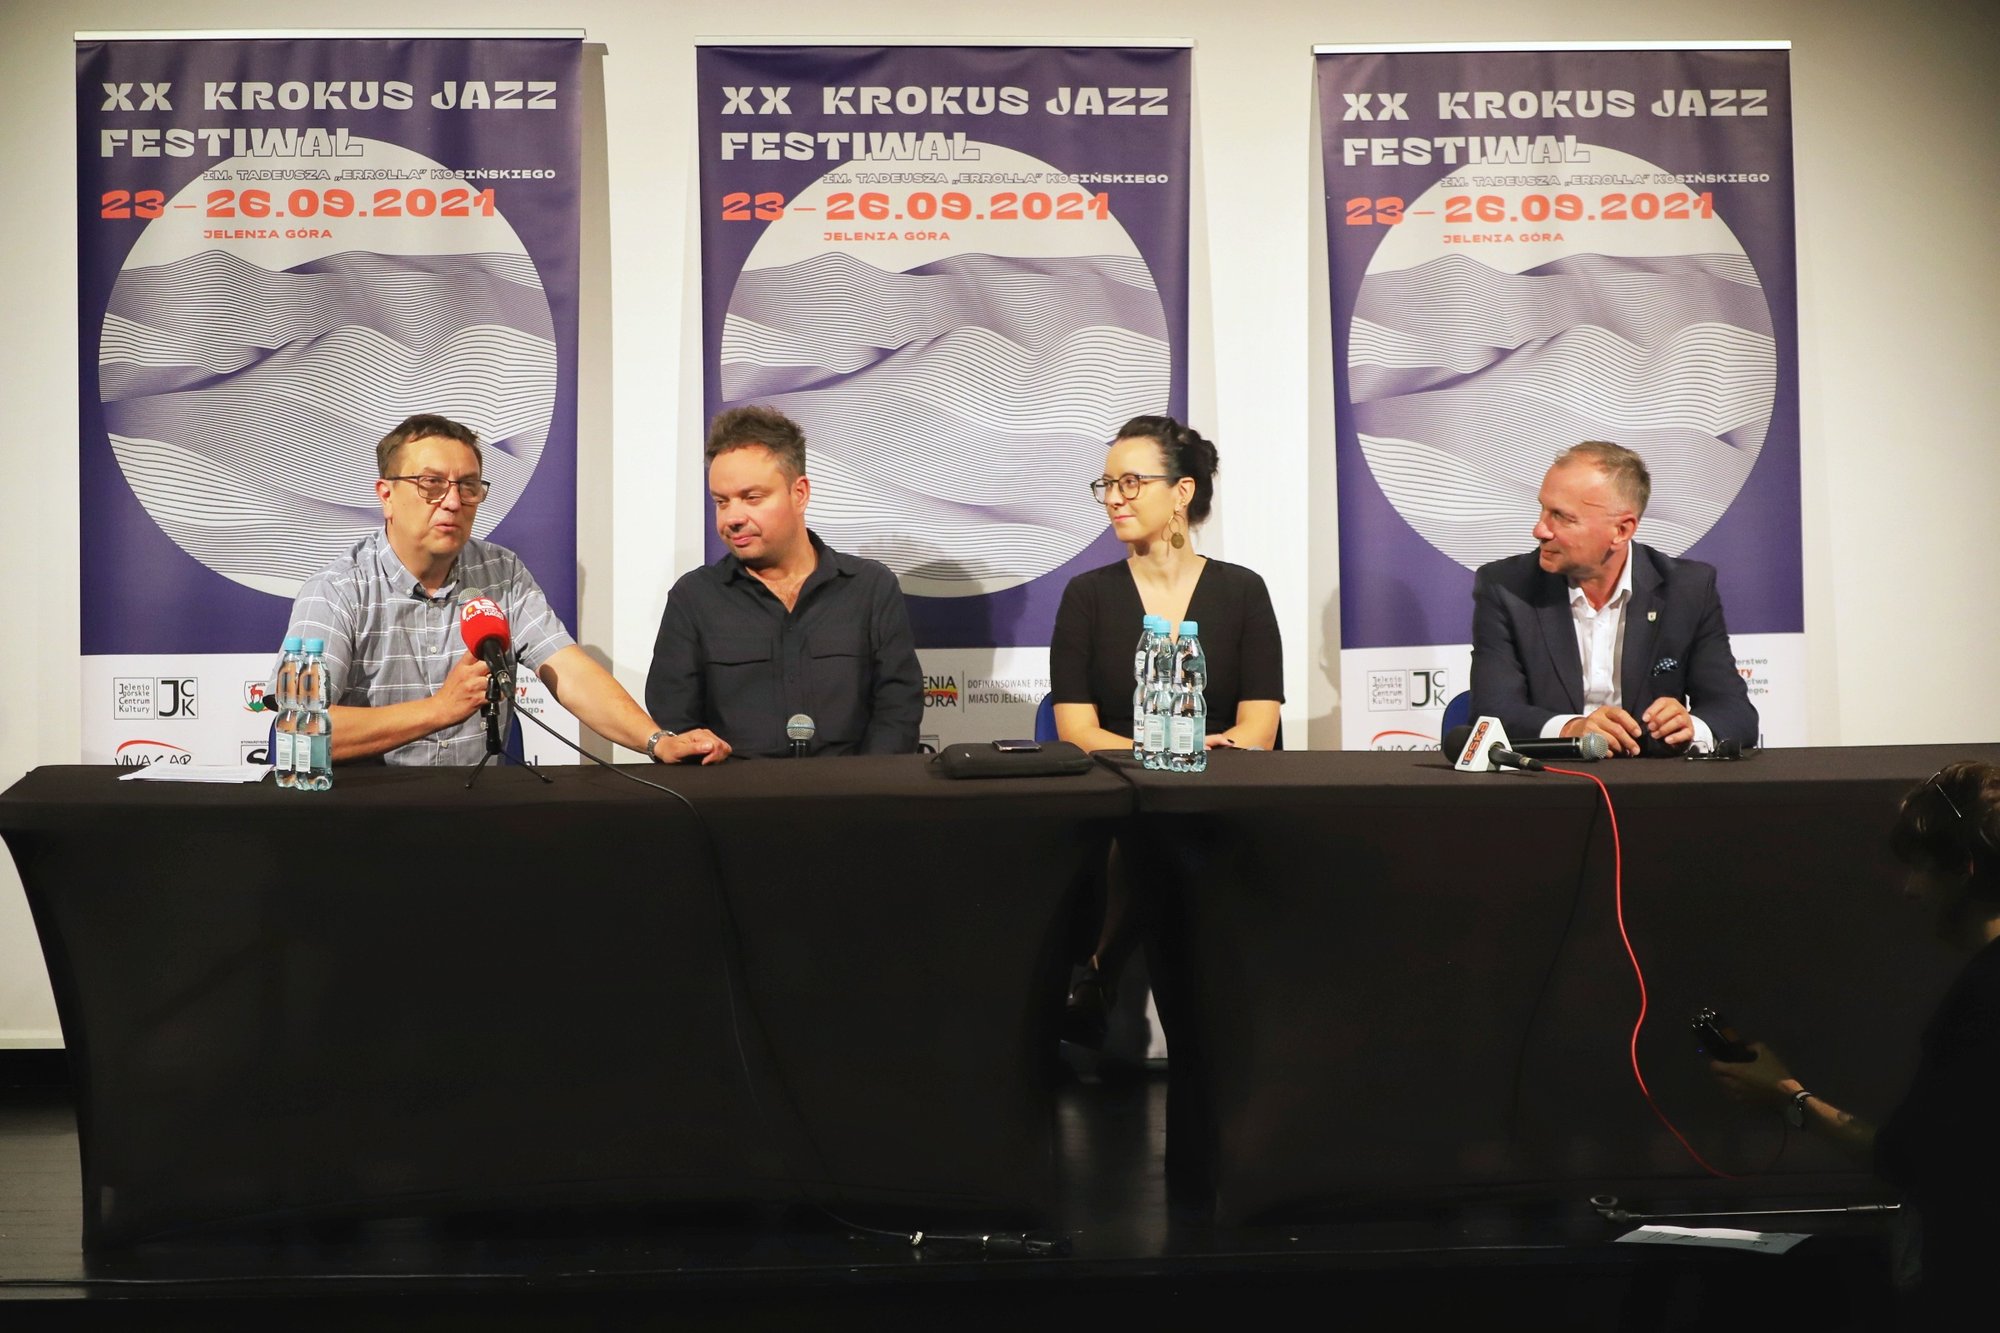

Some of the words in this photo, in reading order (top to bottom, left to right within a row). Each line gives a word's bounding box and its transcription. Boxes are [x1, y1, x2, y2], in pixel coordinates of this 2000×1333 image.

[101, 83, 172, 111] XX
[204, 81, 415, 110] KROKUS
[431, 81, 557, 110] JAZZ
[721, 86, 792, 115] XX
[823, 86, 1029, 115] KROKUS
[1045, 87, 1169, 115] JAZZ
[1342, 92, 1409, 121] XX
[1438, 90, 1636, 120] KROKUS
[1651, 89, 1769, 117] JAZZ
[100, 128, 364, 158] FESTIWAL
[721, 132, 980, 161] FESTIWAL
[1344, 135, 1591, 166] FESTIWAL
[203, 169, 232, 180] IM.
[237, 170, 330, 181] TADEUSZA
[431, 167, 556, 180] KOSIŃSKIEGO
[823, 174, 852, 184] IM.
[855, 174, 949, 184] TADEUSZA
[1046, 171, 1168, 184] KOSIŃSKIEGO
[1441, 177, 1469, 187] IM.
[1472, 176, 1562, 187] TADEUSZA
[1653, 171, 1770, 184] KOSIŃSKIEGO
[101, 189, 165, 219] 23
[206, 188, 495, 218] 26.09.2021
[722, 192, 785, 221] 23
[826, 192, 1110, 221] 26.09.2021
[1345, 196, 1404, 226] 23
[1444, 192, 1714, 224] 26.09.2021
[203, 230, 280, 239] JELENIA
[285, 228, 333, 239] GÓRA
[823, 232, 899, 241] JELENIA
[904, 230, 950, 241] GÓRA
[1442, 234, 1514, 244] JELENIA
[1519, 231, 1564, 243] GÓRA
[119, 683, 150, 694] Jelenio
[923, 676, 957, 689] ENIA
[968, 679, 1030, 689] DOFINANSOWANE
[1034, 679, 1051, 688] PRZE
[119, 697, 150, 705] Centrum
[924, 691, 957, 707] ÓRA
[968, 693, 999, 704] MIASTO
[1000, 693, 1032, 704] JELENIA
[1373, 697, 1402, 705] Kultury
[119, 705, 150, 714] Kultury
